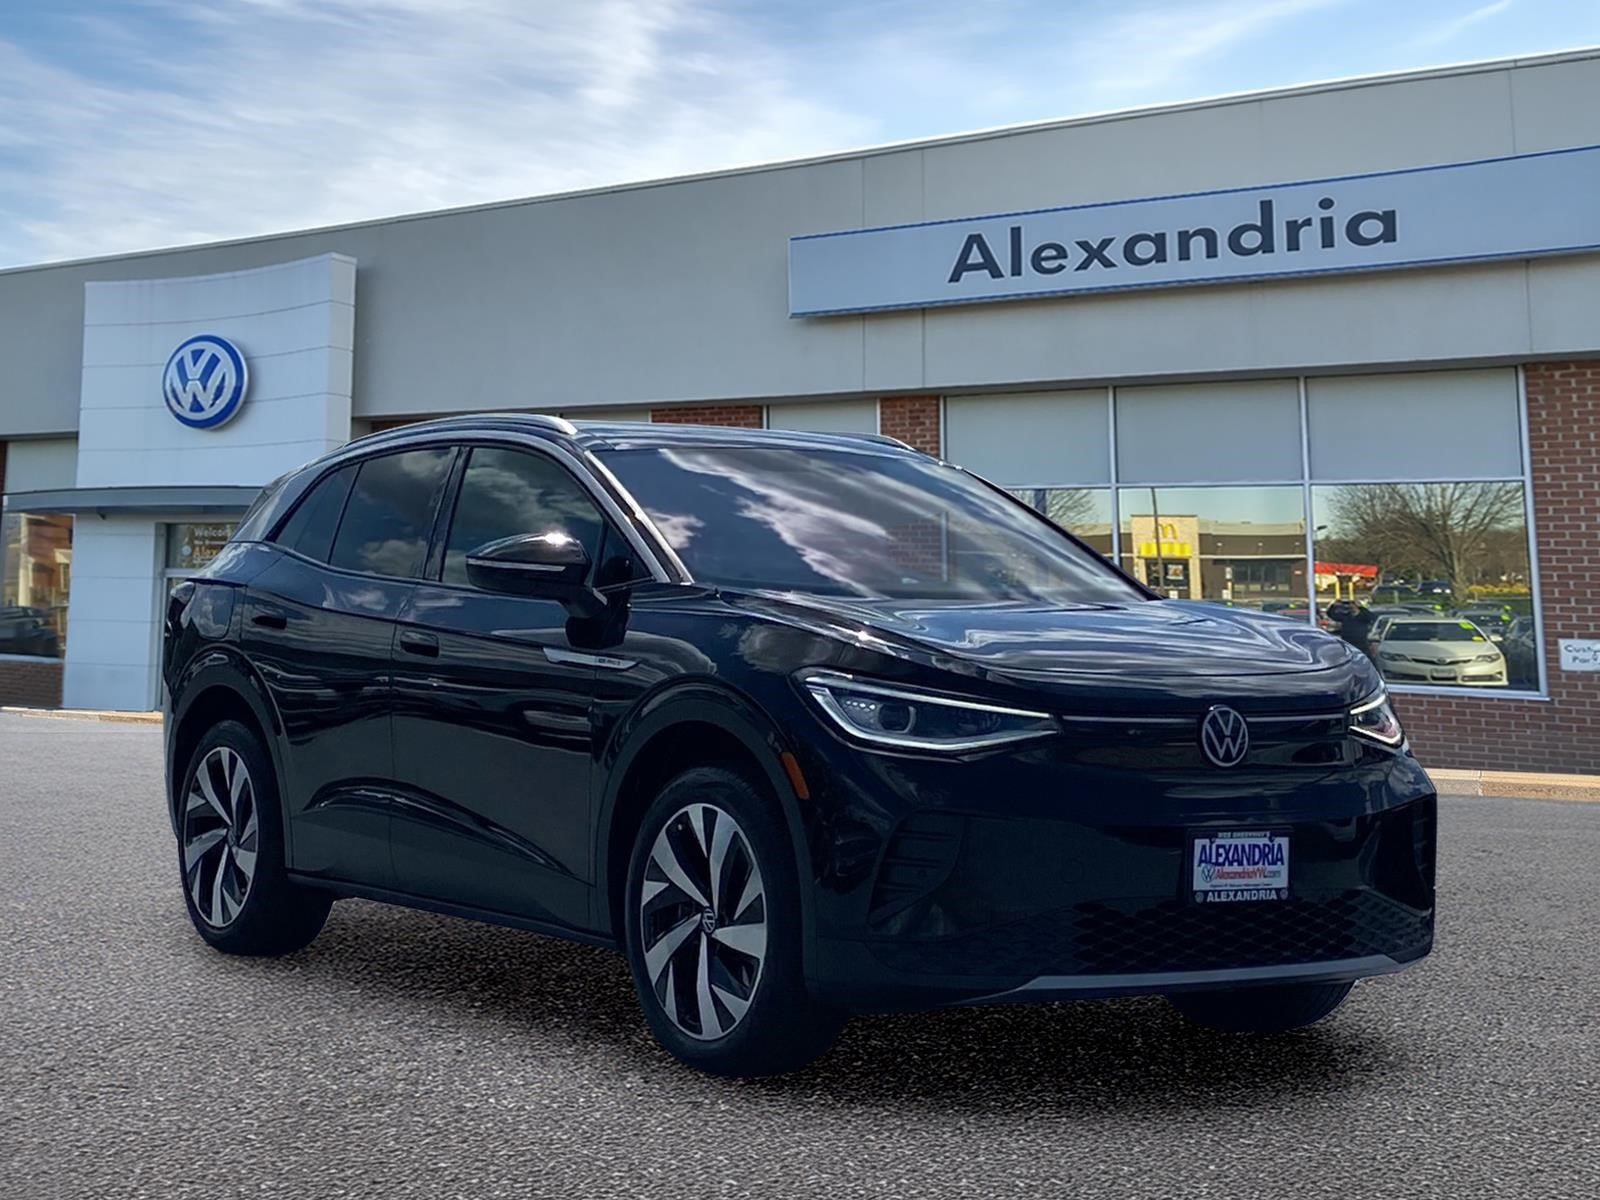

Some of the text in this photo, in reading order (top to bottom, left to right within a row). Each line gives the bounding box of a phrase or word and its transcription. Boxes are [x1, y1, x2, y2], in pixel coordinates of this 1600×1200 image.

[948, 197, 1398, 283] Alexandria
[166, 343, 235, 419] VW
[1203, 708, 1247, 763] VW
[1198, 843, 1284, 866] ALEXANDRIA
[1207, 890, 1277, 902] ALEXANDRIA
